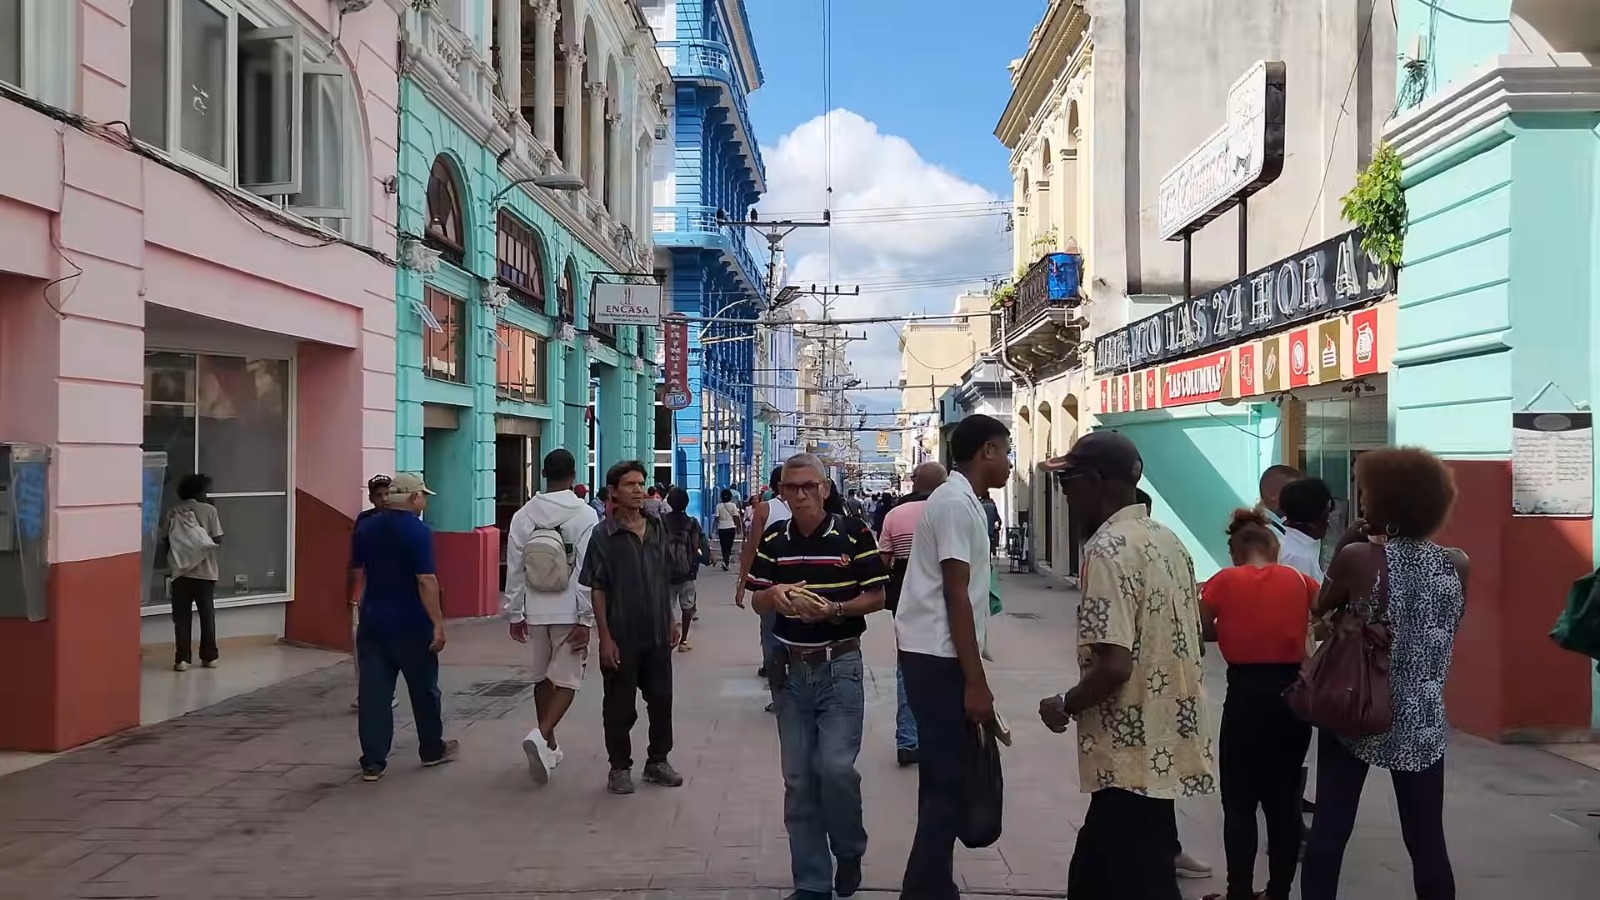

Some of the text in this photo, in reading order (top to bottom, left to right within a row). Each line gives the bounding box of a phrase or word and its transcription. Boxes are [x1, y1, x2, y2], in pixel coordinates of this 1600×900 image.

[606, 305, 650, 314] ENCASA
[1165, 300, 1207, 350] LAS
[1212, 283, 1242, 336] 24
[1249, 234, 1392, 326] HORAS
